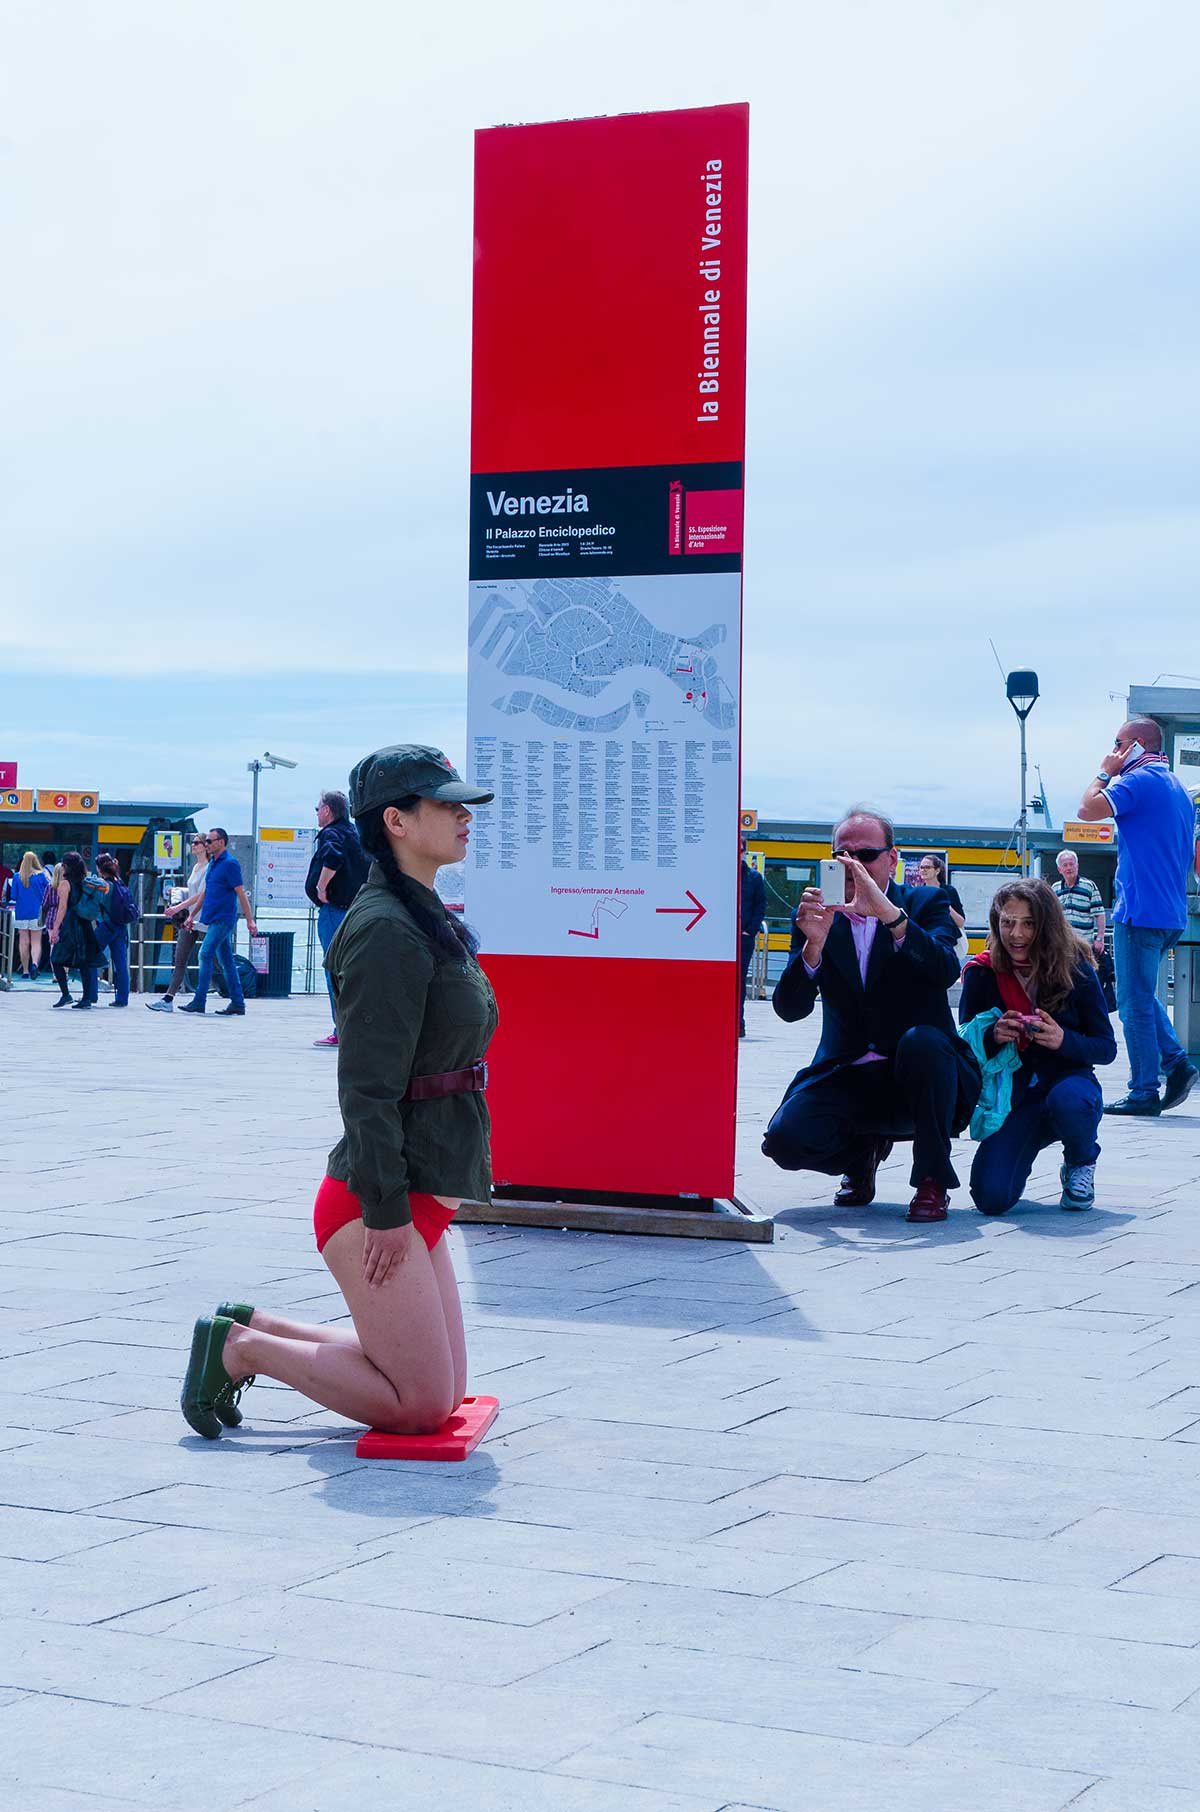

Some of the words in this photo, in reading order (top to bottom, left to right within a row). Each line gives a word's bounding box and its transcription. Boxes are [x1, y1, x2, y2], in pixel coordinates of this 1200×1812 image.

[700, 159, 722, 251] Venezia
[699, 260, 721, 281] di
[697, 289, 720, 393] Biennale
[697, 401, 719, 422] la
[486, 487, 589, 516] Venezia
[486, 528, 493, 539] Il
[495, 527, 536, 539] Palazzo
[538, 524, 616, 538] Enciclopedico
[697, 525, 727, 534] Esposizione
[688, 532, 725, 540] Internazionale
[9, 796, 16, 804] N
[57, 797, 64, 806] 2
[84, 798, 91, 807] 8
[744, 816, 751, 825] 8
[550, 886, 613, 895] Ingresso/entrance
[614, 887, 645, 895] Arsenale
